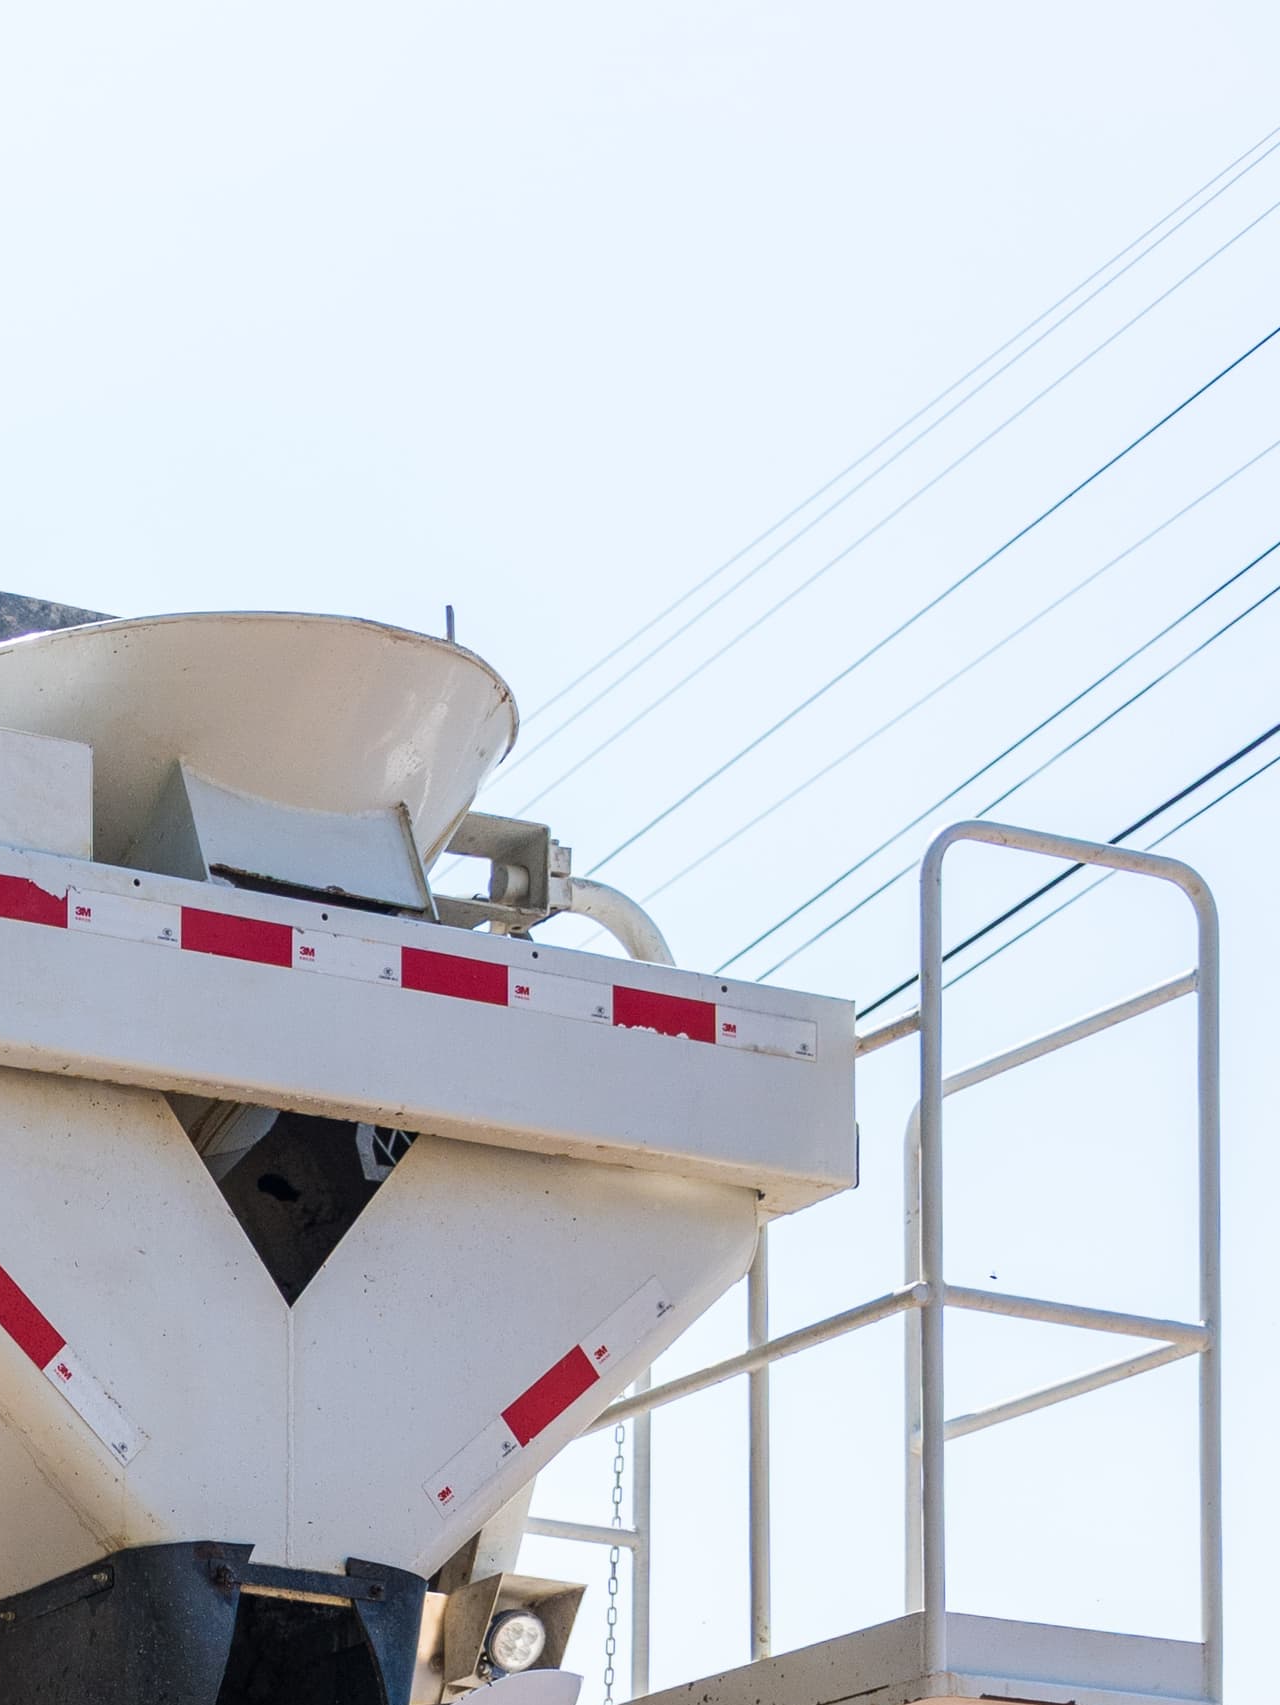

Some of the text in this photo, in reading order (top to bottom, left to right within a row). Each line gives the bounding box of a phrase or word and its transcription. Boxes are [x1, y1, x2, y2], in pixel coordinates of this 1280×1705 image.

[75, 906, 91, 917] 3M
[299, 946, 315, 957] 3M
[515, 984, 530, 996] 3M
[722, 1023, 737, 1033] 3M
[593, 1345, 608, 1360] 3M
[56, 1363, 72, 1380] 3M
[437, 1486, 452, 1501] 3M
